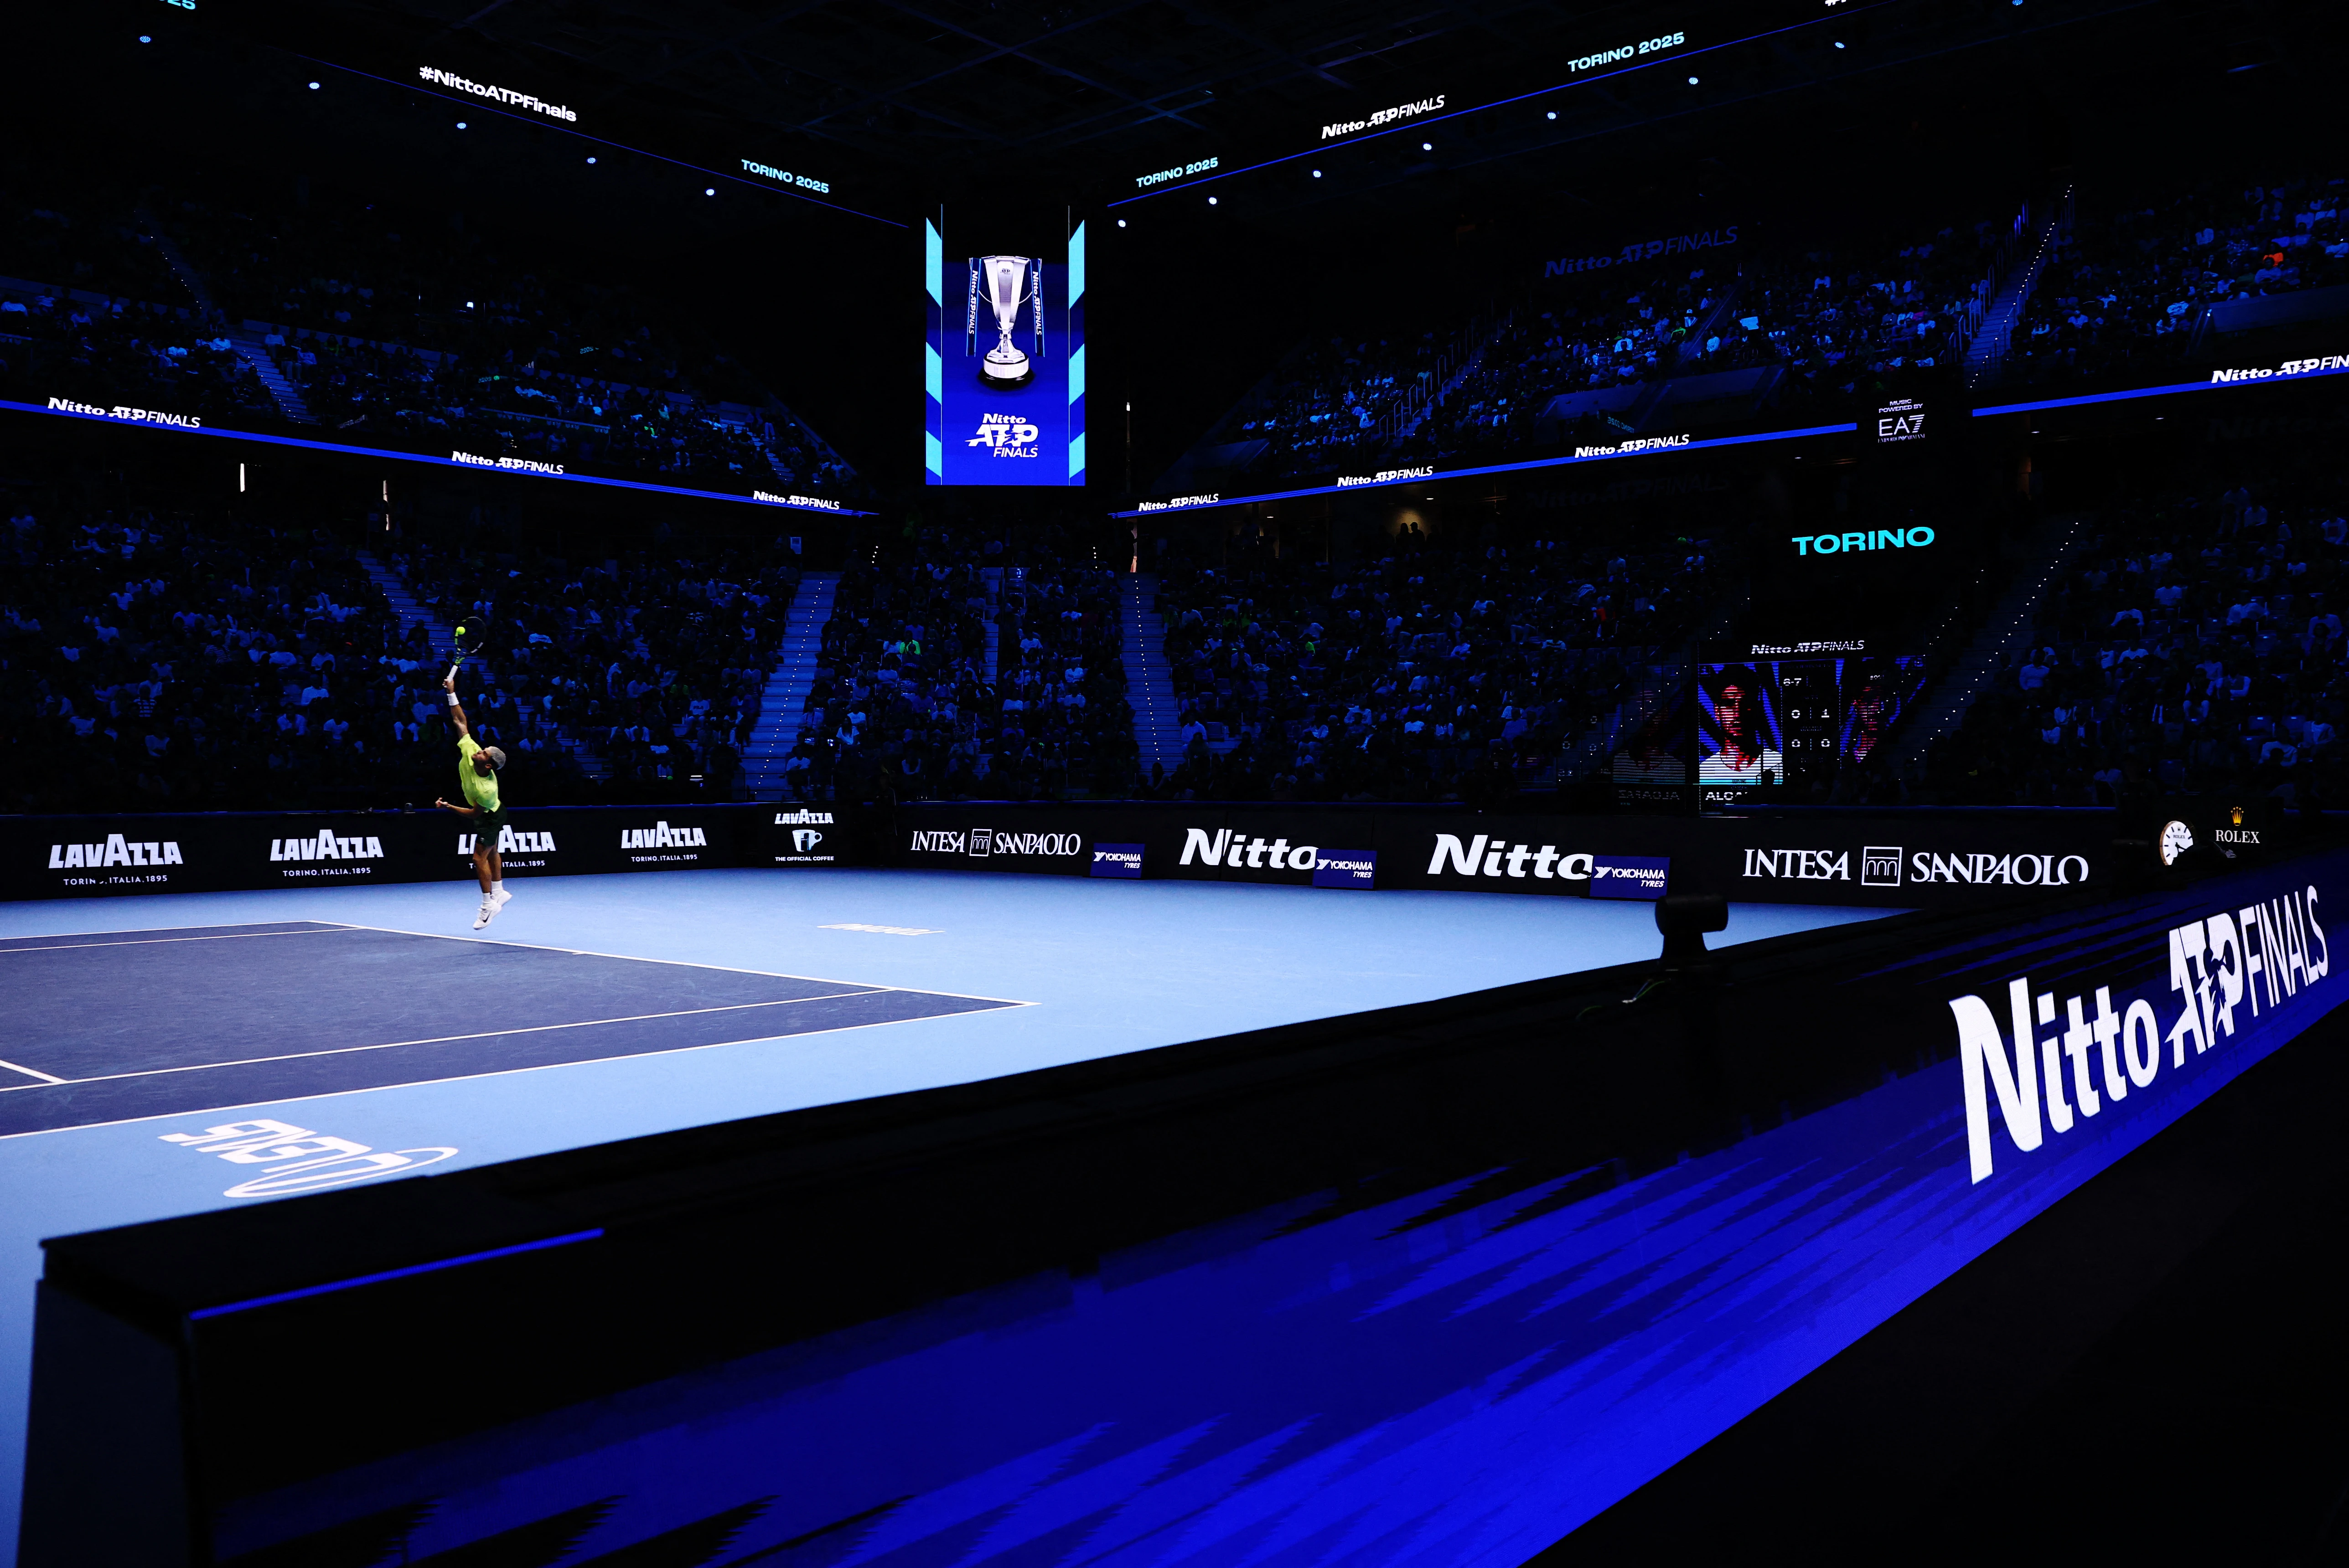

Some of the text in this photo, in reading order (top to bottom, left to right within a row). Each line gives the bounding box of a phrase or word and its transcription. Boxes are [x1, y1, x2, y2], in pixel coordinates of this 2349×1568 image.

[1568, 31, 1685, 72] TORINO 2025
[419, 66, 577, 122] #NittoATPFinals
[1321, 120, 1365, 139] Nitto
[1398, 95, 1445, 119] FINALS
[741, 159, 829, 193] TORINO 2025
[1136, 157, 1218, 188] TORINO 2025
[1544, 253, 1612, 278] Nitto
[1664, 226, 1738, 255] FINALS
[2211, 368, 2273, 383] Nitto
[2274, 358, 2320, 376] ATP
[47, 397, 105, 416] Nitto
[146, 411, 201, 428] FINALS
[982, 413, 1026, 424] Nitto
[1878, 405, 1913, 413] POWERED
[965, 424, 1039, 447] ATP
[1879, 414, 1925, 437] EA7
[993, 447, 1038, 458] FINALS
[1574, 446, 1615, 458] Nitto
[1646, 434, 1690, 449] FINALS
[451, 451, 494, 466] Nitto
[523, 460, 564, 475] FINALS
[1337, 476, 1371, 487] Nitto
[1397, 466, 1433, 480] FINALS
[753, 490, 786, 503] Nitto
[808, 498, 840, 510] FINALS
[1138, 502, 1168, 512] Nitto
[1188, 493, 1219, 506] FINALS
[1792, 526, 1935, 556] TORINO
[1751, 645, 1791, 654] Nitto
[1822, 640, 1865, 651] FINALS
[774, 809, 834, 824] LAVAZZA
[270, 829, 384, 861] LAVAZZA
[621, 821, 707, 849] LAVAZZA
[910, 830, 1081, 856] INTESA SANPAOLO
[2215, 830, 2260, 843] ROLEX
[48, 834, 183, 868] LAVAZZA
[1105, 853, 1141, 862] YOKOHAMA
[1179, 828, 1319, 870] Nitto
[1427, 834, 1594, 880] Nitto
[1330, 860, 1373, 871] YOKOHAMA
[1611, 867, 1665, 879] YOKOHAMA
[1742, 849, 2089, 886] INTESA SANPAOLO
[1949, 885, 2328, 1185] Nitto ATP FINALS
